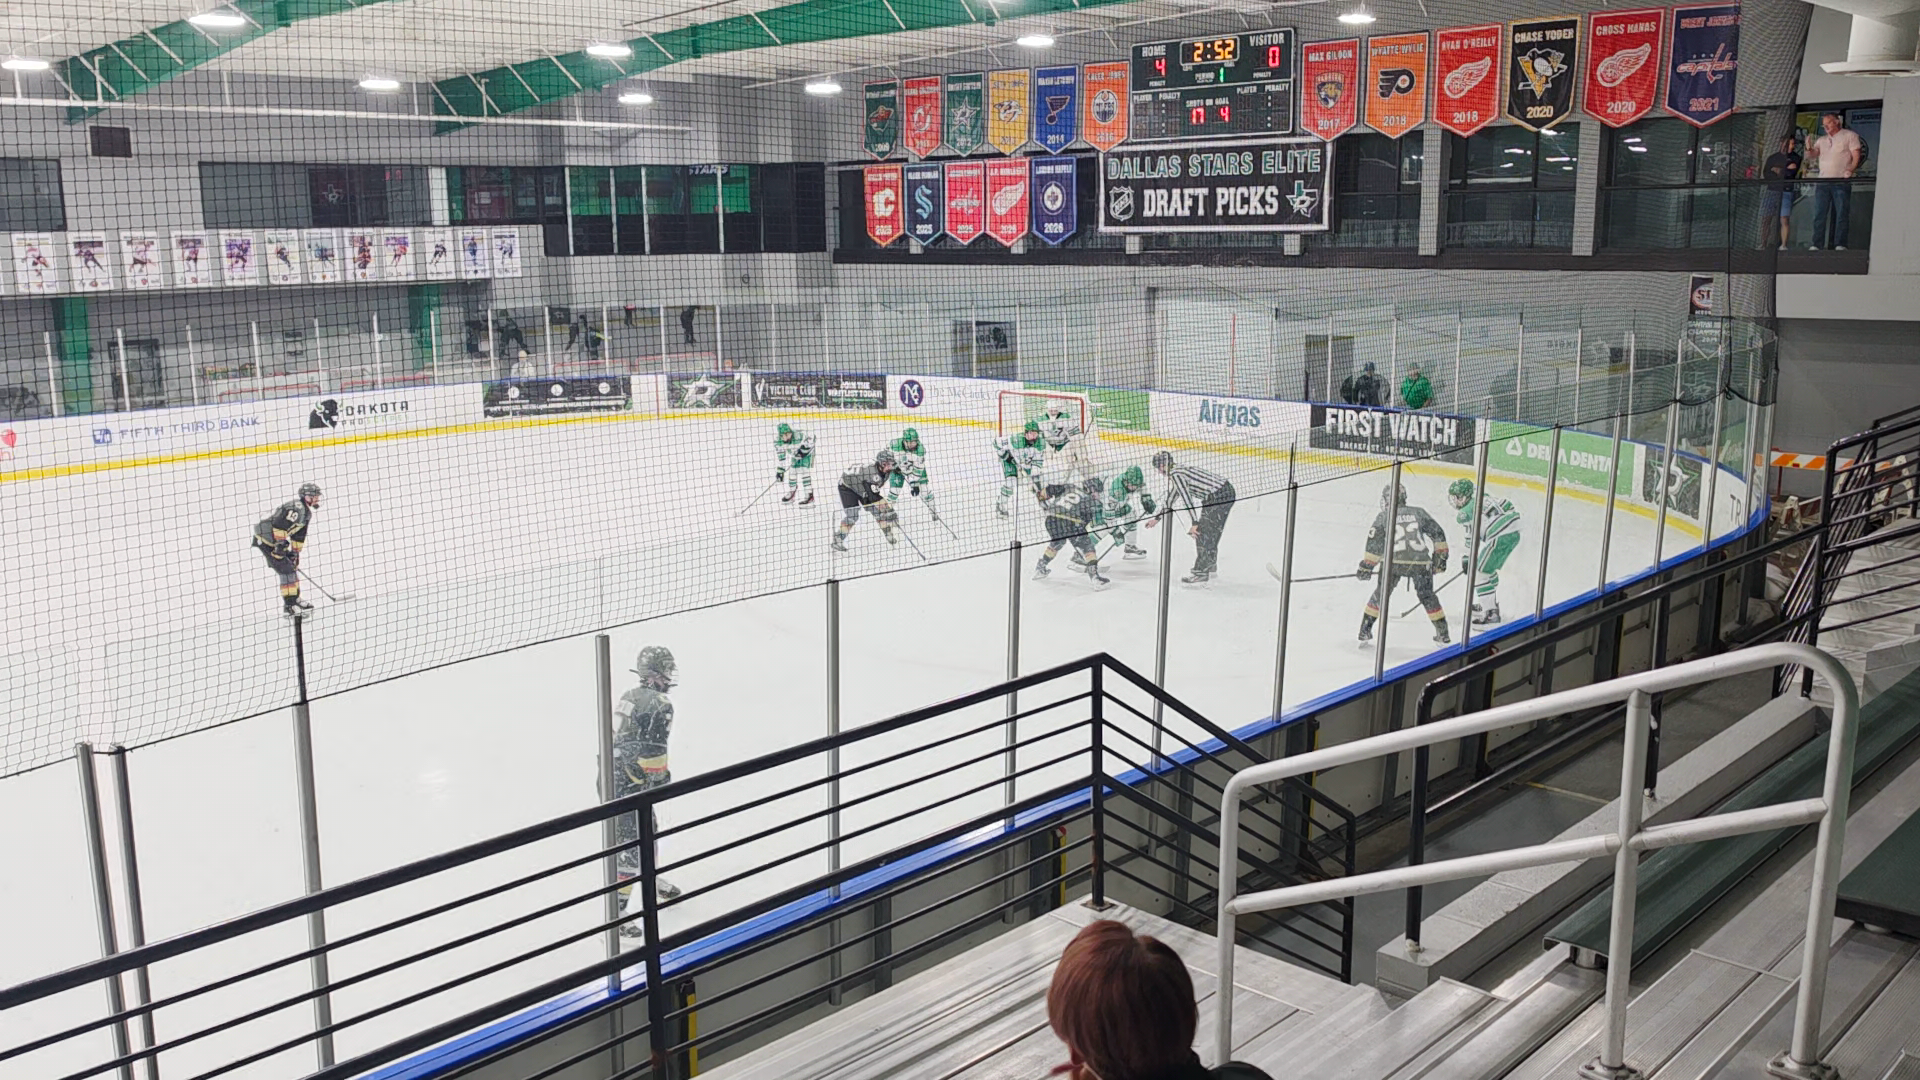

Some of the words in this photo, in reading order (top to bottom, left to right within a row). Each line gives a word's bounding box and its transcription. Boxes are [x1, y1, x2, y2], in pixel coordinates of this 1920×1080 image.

[1514, 31, 1543, 43] CHASE
[1545, 28, 1574, 40] YODER
[1595, 24, 1625, 36] CROSS
[1627, 22, 1657, 33] HANAS
[1249, 33, 1285, 46] VISITOR
[1463, 36, 1497, 49] O'REILLY
[1141, 45, 1167, 58] HOME
[1193, 38, 1235, 62] 2:52
[1308, 52, 1325, 62] MAX
[1155, 58, 1167, 78] 4
[1219, 67, 1225, 83] 1
[1236, 86, 1258, 94] PLAYER
[1265, 83, 1290, 92] PENALTY
[1158, 92, 1181, 100] PENALTY
[1185, 99, 1204, 108] SHOTS
[1205, 98, 1214, 106] ON
[1606, 101, 1637, 114] 2020
[1220, 105, 1231, 122] 4
[1453, 111, 1479, 123] 2018
[1526, 106, 1554, 118] 2020
[1317, 118, 1341, 130] 2017
[1383, 115, 1407, 126] 2018
[1046, 134, 1065, 144] 2014
[1107, 155, 1181, 180] DALLAS
[1188, 152, 1254, 177] STARS
[1261, 149, 1321, 175] ELITE
[1142, 187, 1209, 217] DRAFT
[1215, 185, 1279, 217] PICKS
[1044, 222, 1064, 233] 2026
[345, 401, 409, 416] DAKOTA
[1199, 399, 1262, 428] Airgas
[120, 425, 165, 440] FIFTH
[171, 420, 216, 434] THIRD
[219, 416, 261, 430] BANK
[1325, 407, 1385, 438] FIRST
[1388, 412, 1457, 446] WATCH
[1527, 443, 1568, 464] DELA
[1569, 450, 1620, 475] DENTA
[1393, 521, 1427, 553] 23
